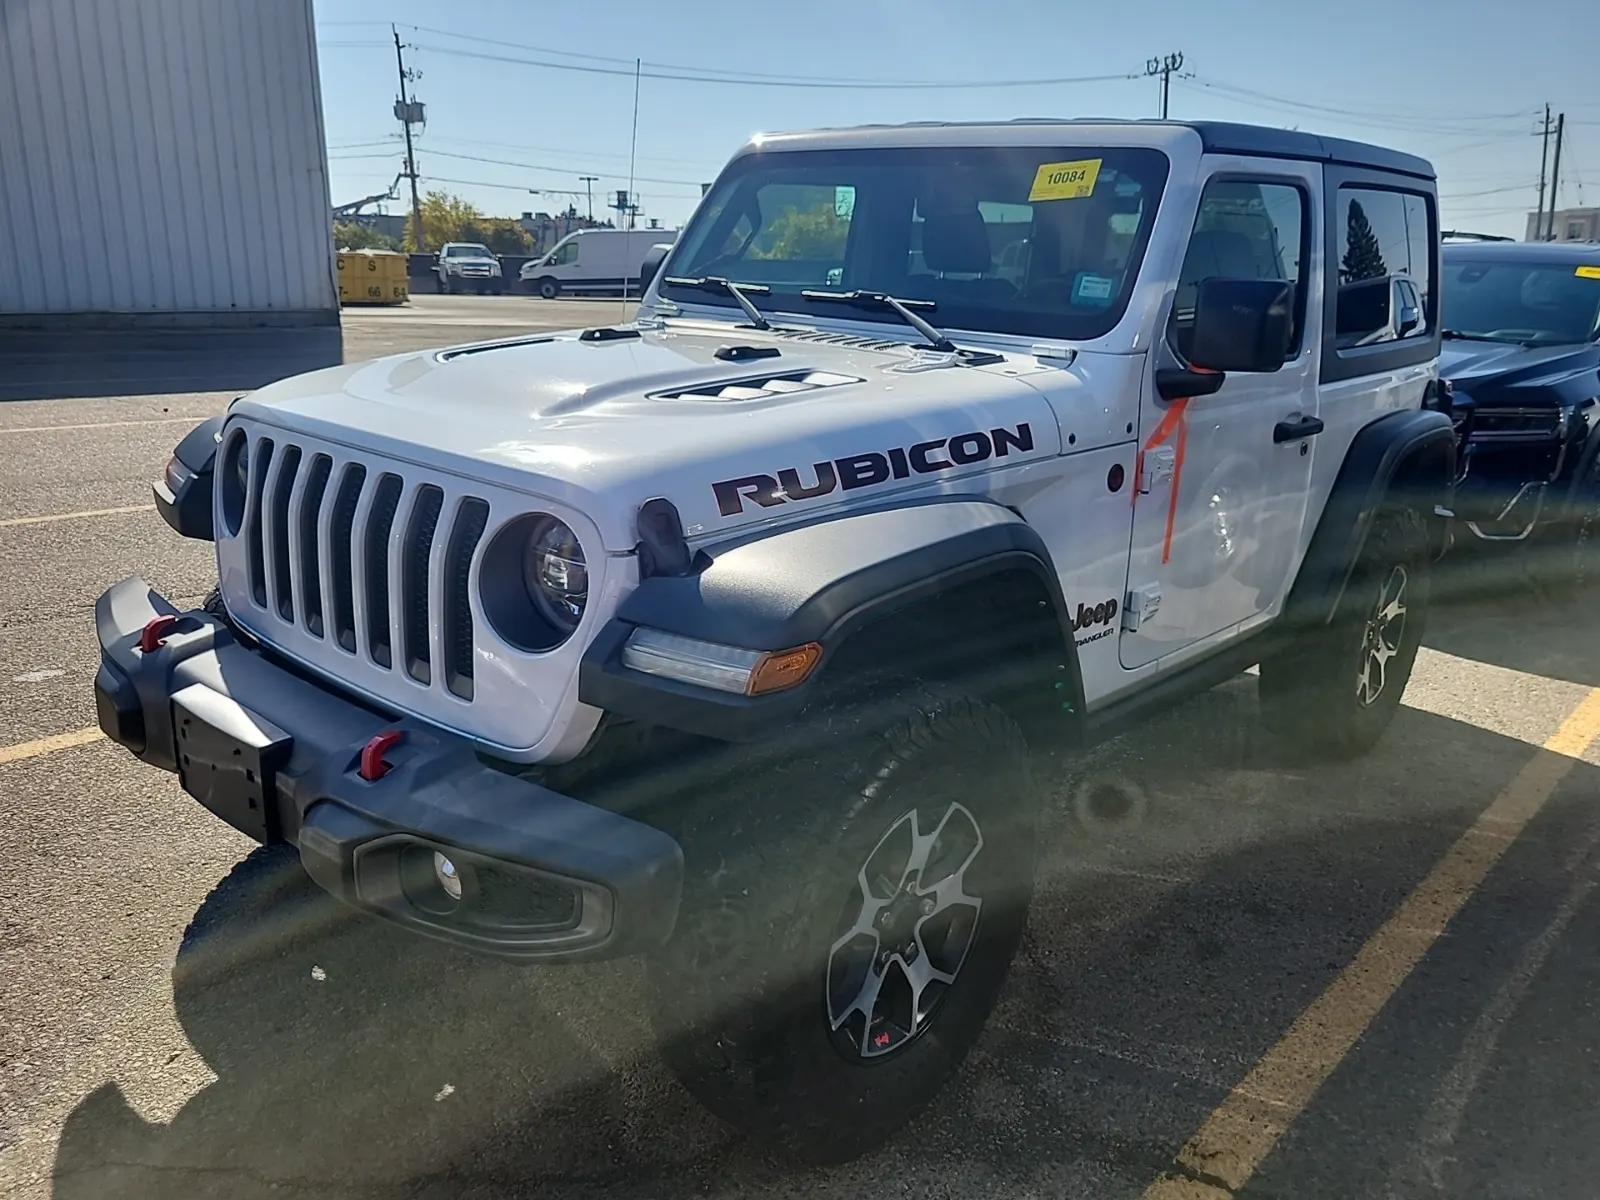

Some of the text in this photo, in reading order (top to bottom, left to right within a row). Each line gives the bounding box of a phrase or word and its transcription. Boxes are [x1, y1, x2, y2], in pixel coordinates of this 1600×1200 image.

[1047, 170, 1086, 185] 10084
[711, 422, 1035, 517] RUBICON
[1072, 598, 1118, 631] Jeep
[1074, 627, 1114, 648] RANGLER
